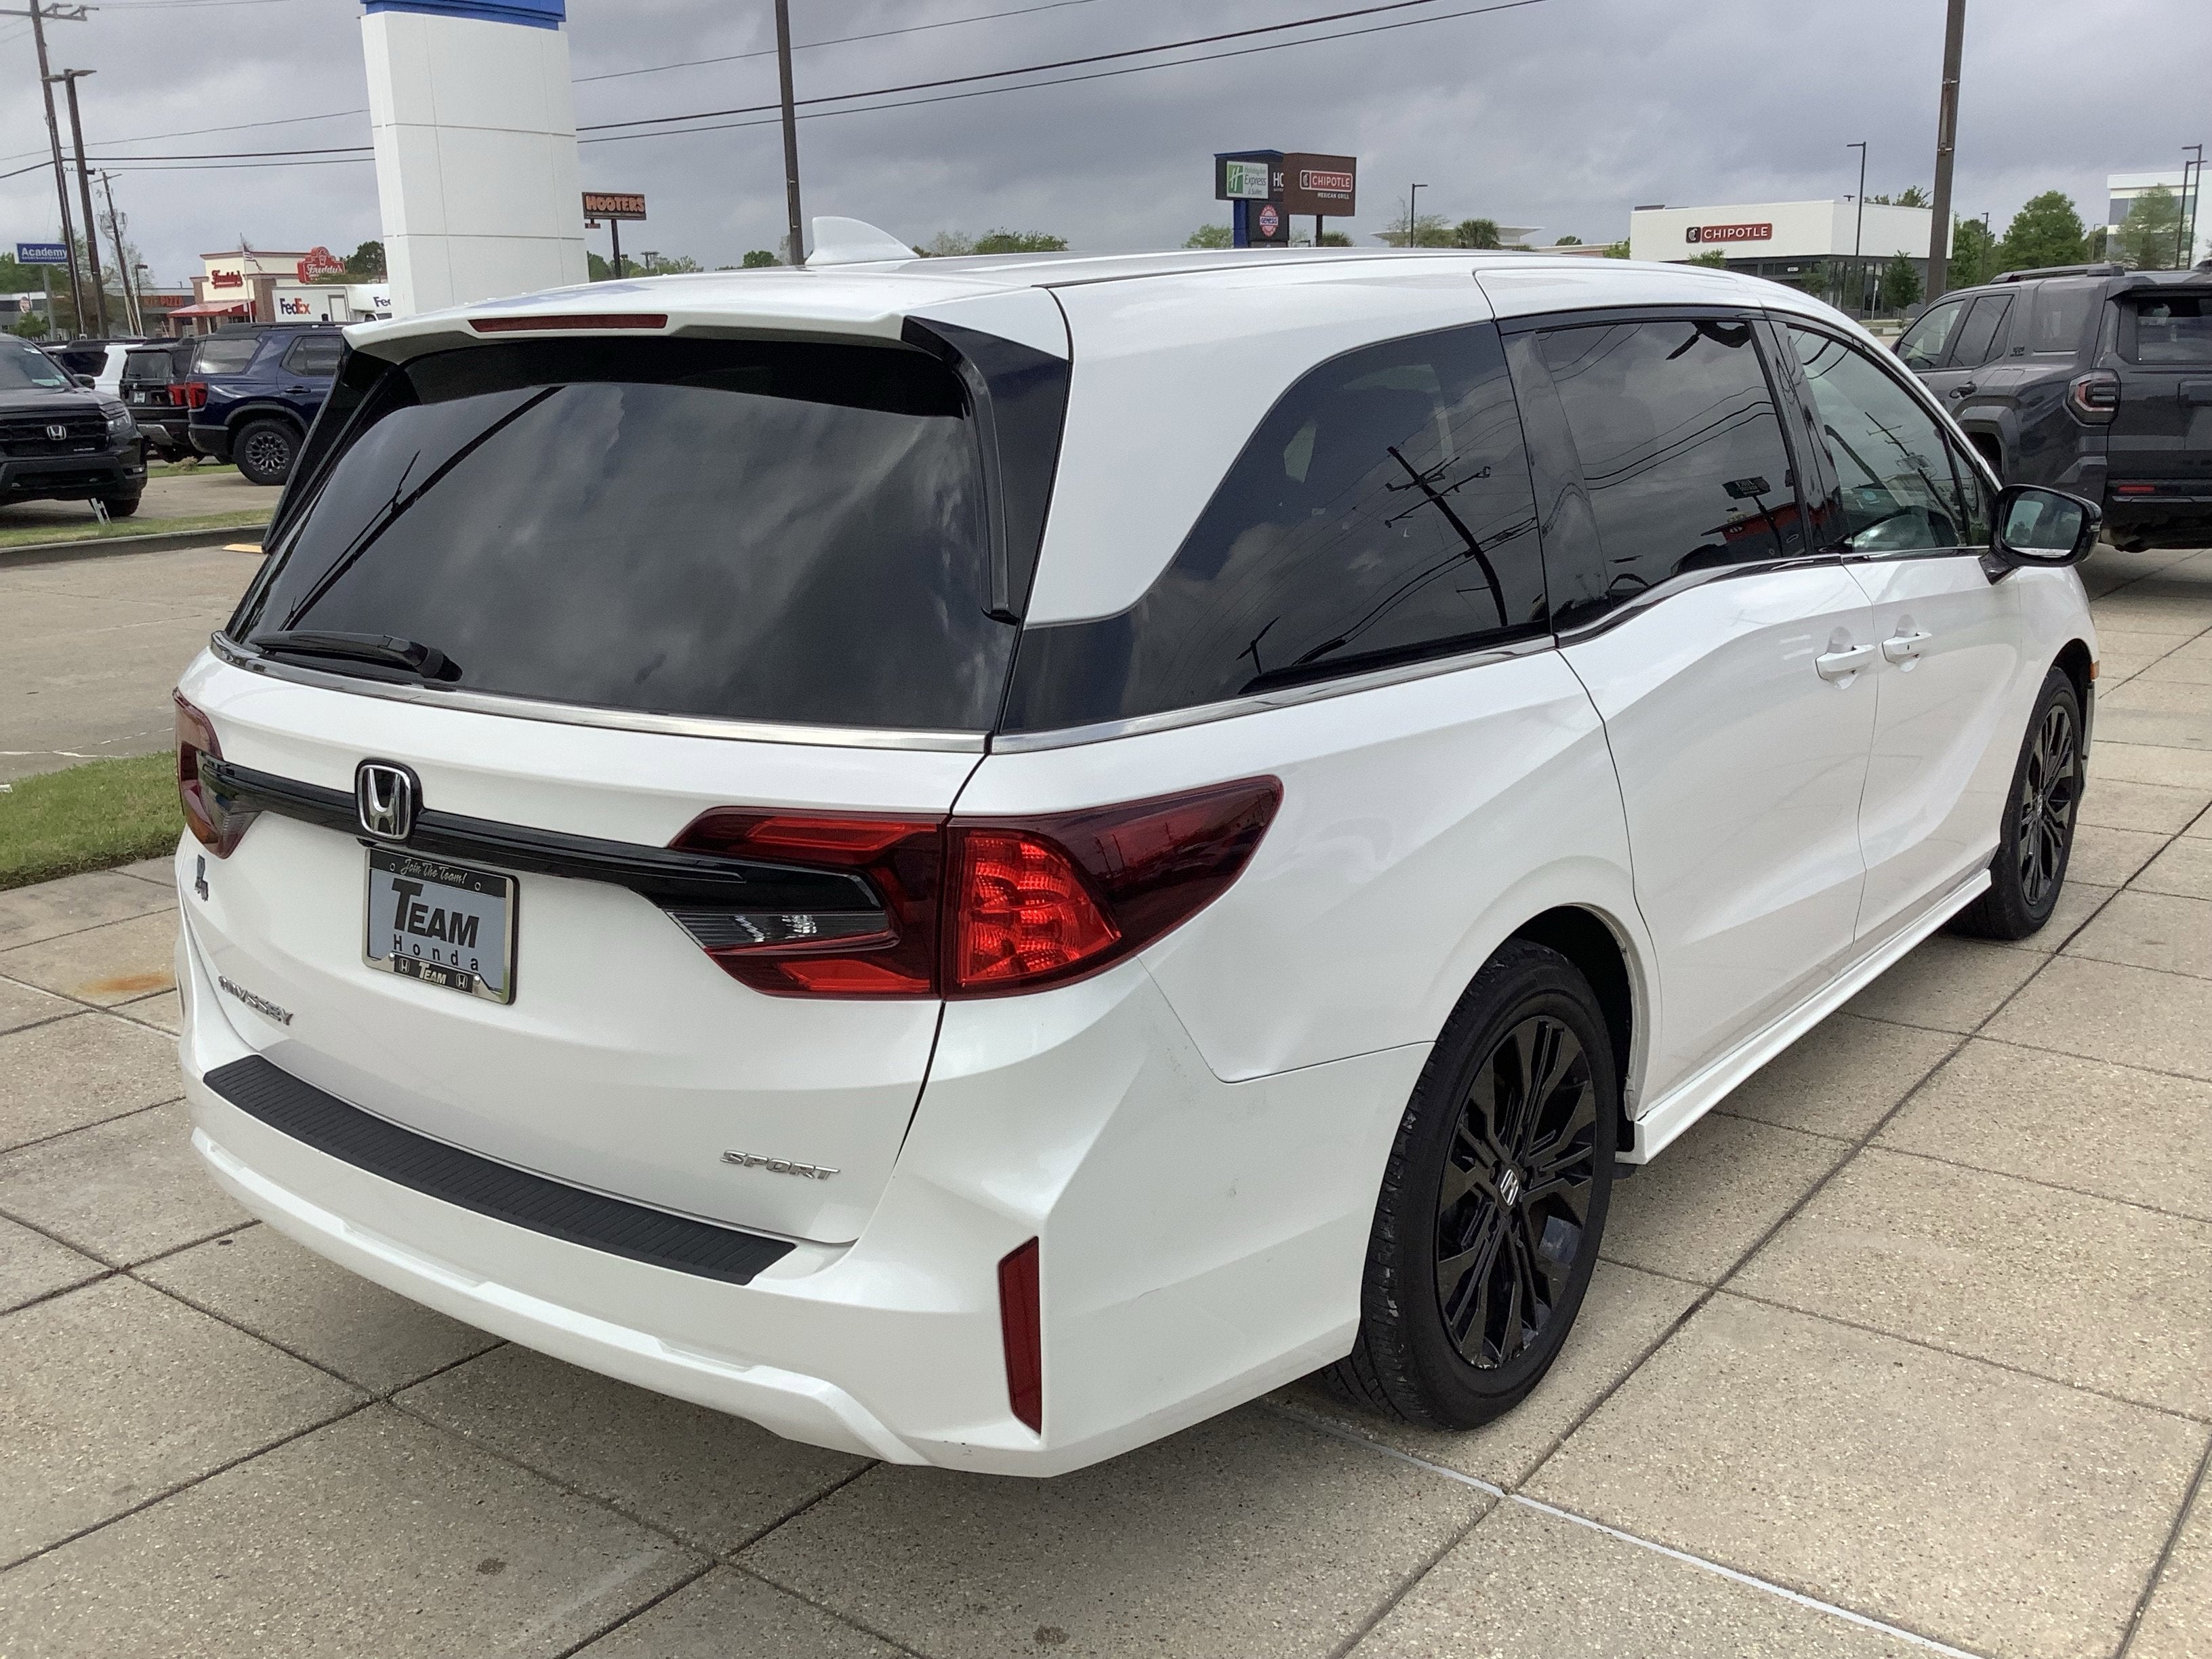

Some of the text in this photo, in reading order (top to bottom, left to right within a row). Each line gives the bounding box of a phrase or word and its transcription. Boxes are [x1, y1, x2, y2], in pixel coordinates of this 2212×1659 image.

[1244, 174, 1267, 186] Express
[1312, 176, 1351, 188] CHIPOTLE
[586, 195, 645, 212] HOOTERS
[1704, 226, 1769, 239] CHIPOTLE
[22, 247, 67, 259] Academy
[279, 298, 311, 314] FedEx
[401, 858, 468, 884] Join The Team!
[393, 934, 479, 972] Honda
[218, 976, 294, 1026] ODYSSEY
[720, 1149, 841, 1181] SPORT
